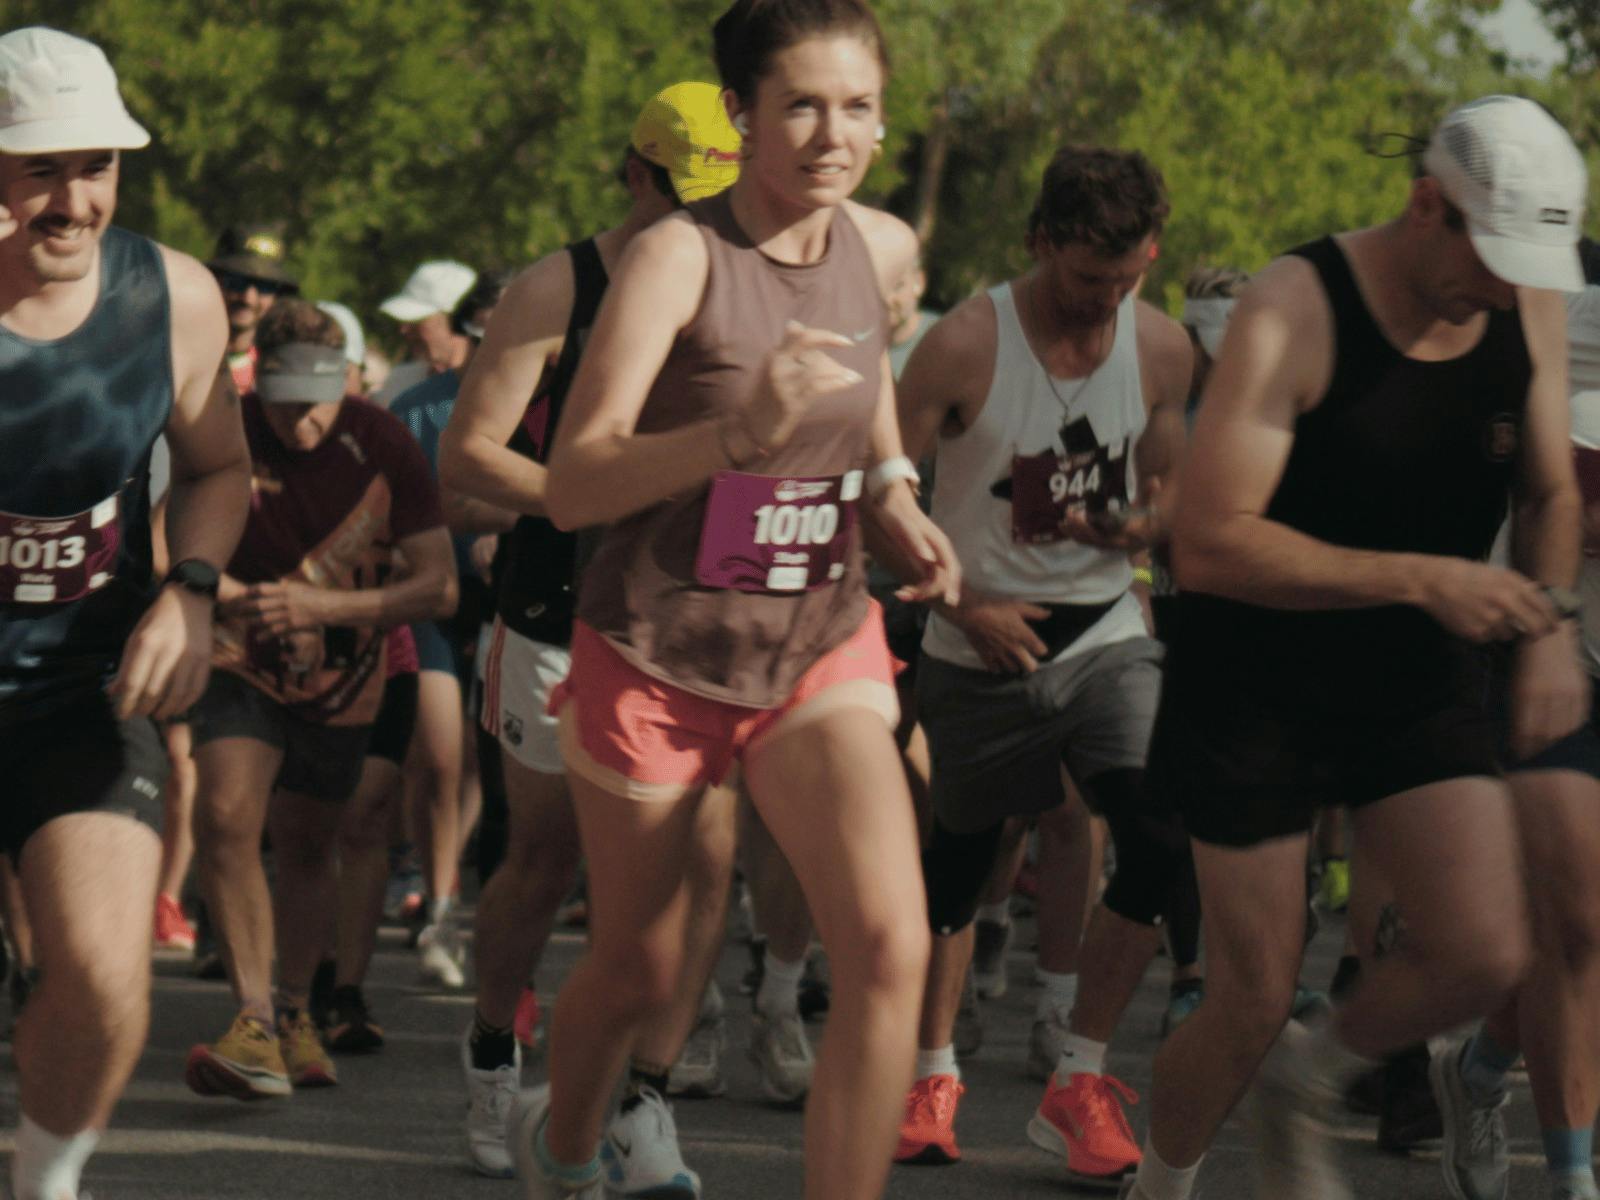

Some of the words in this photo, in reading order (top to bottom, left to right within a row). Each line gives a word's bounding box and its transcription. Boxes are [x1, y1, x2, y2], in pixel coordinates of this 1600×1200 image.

[1048, 463, 1100, 503] 944
[753, 503, 839, 545] 1010
[0, 535, 86, 569] 1013
